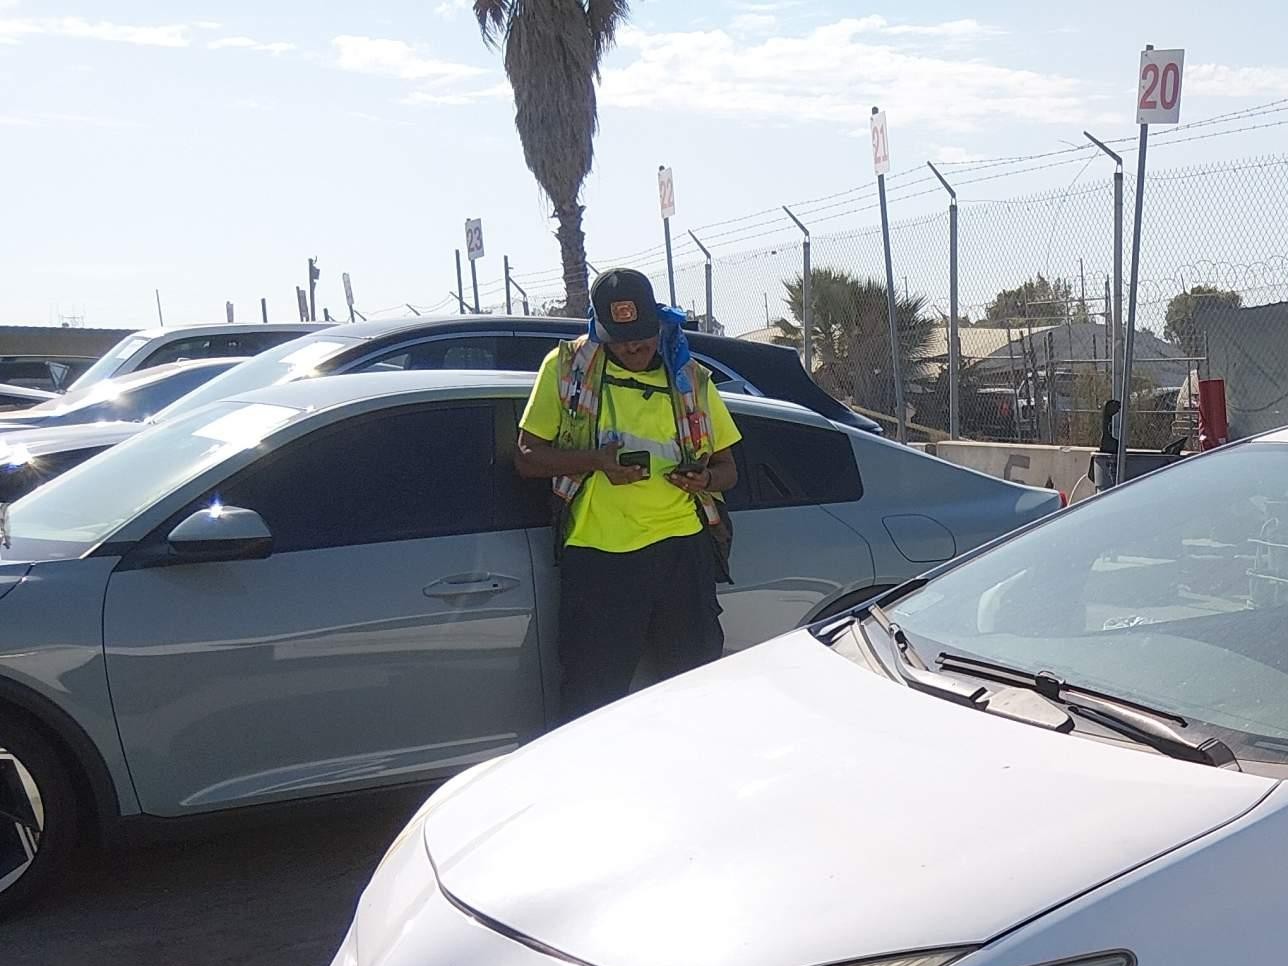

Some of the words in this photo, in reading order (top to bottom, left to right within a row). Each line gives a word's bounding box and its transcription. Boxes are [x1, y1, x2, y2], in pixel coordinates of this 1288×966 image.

[1140, 63, 1180, 110] 20
[872, 124, 888, 164] 21
[660, 179, 674, 208] 22
[466, 227, 482, 252] 23
